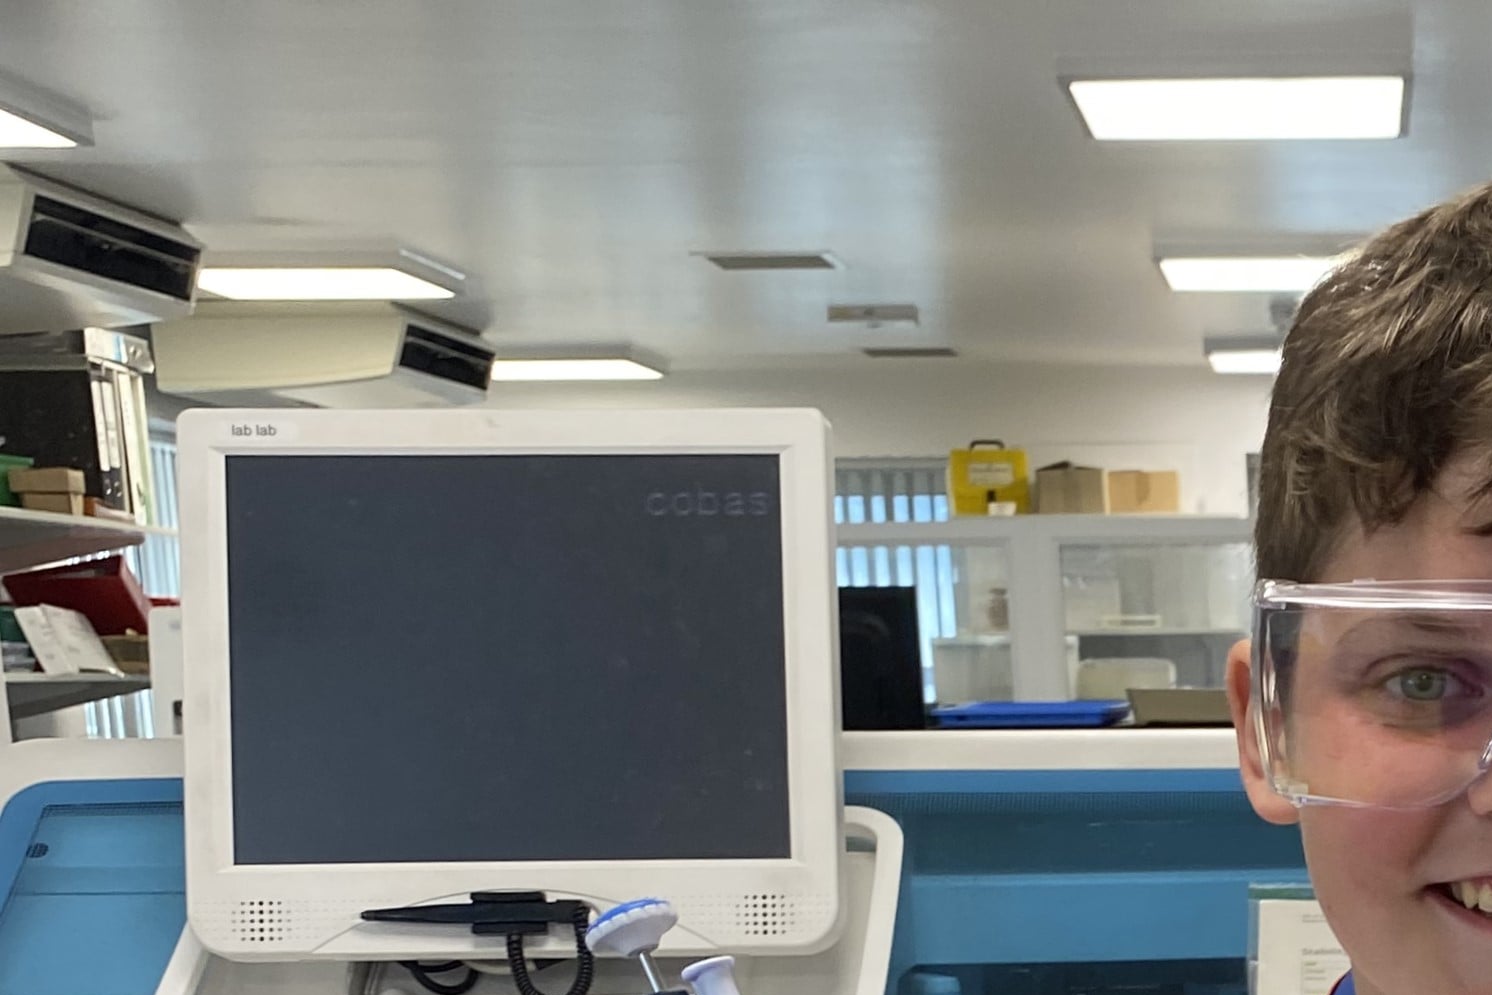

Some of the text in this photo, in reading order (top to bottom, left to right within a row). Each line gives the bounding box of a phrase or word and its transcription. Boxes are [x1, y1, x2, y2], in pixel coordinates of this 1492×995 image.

[231, 424, 278, 437] lab lab
[647, 487, 771, 517] cobas
